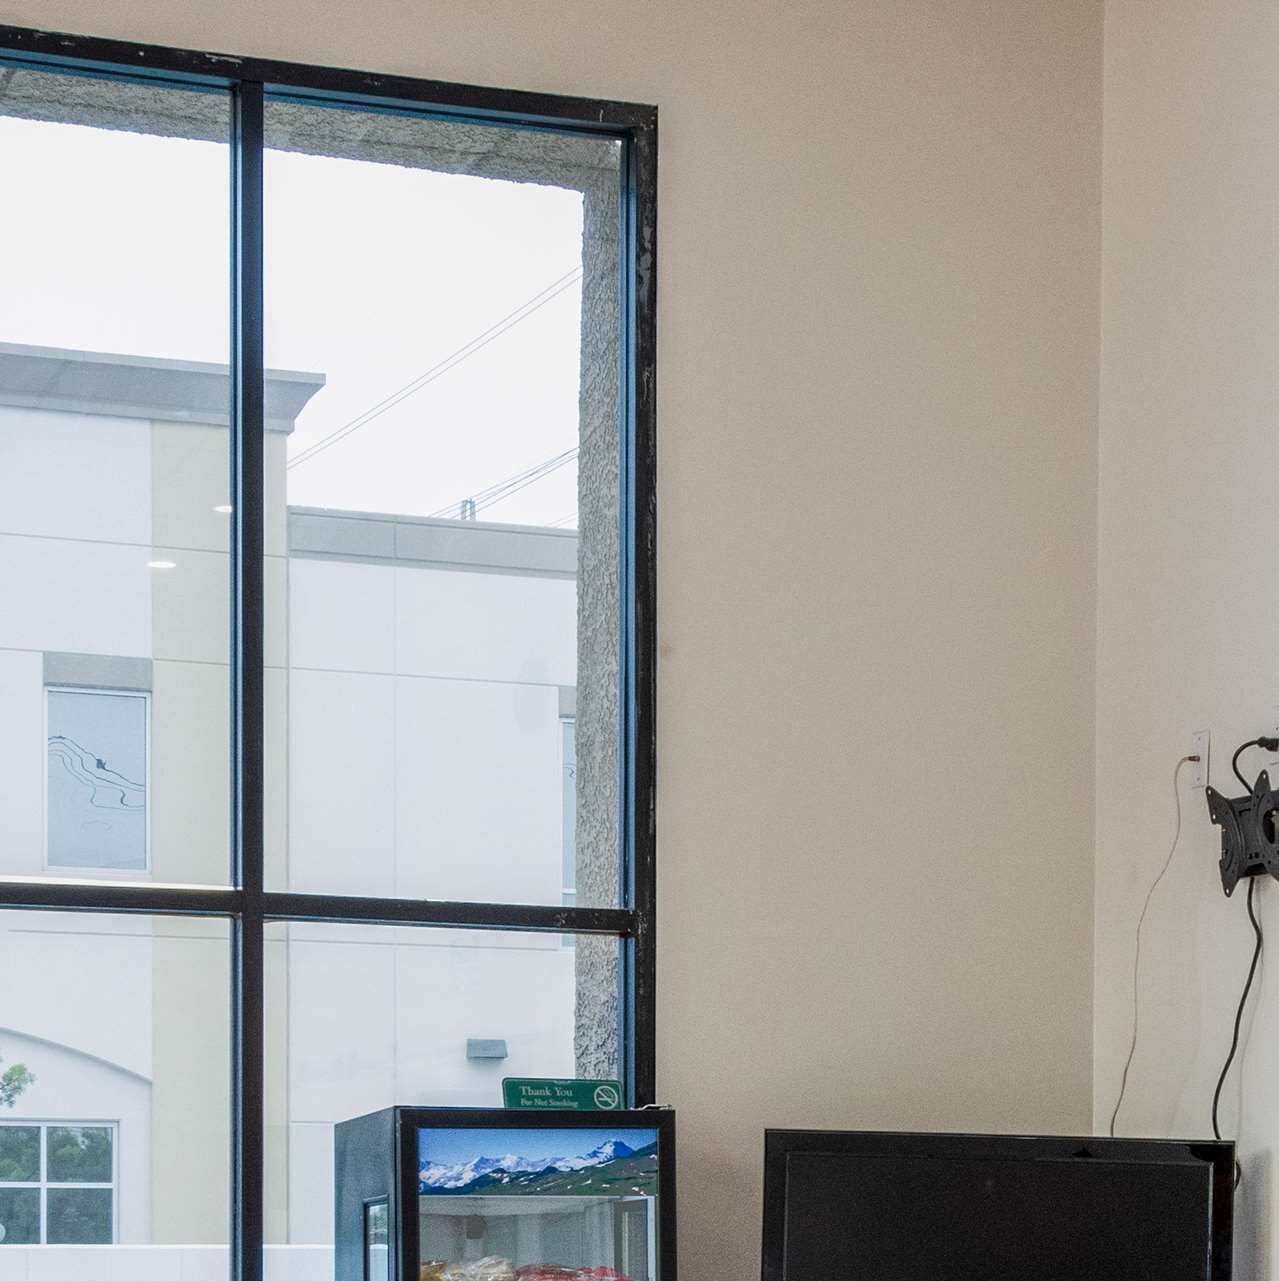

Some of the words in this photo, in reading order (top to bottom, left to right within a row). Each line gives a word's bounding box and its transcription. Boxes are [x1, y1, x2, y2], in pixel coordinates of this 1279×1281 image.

[519, 1086, 552, 1096] Thank
[554, 1087, 573, 1097] You
[549, 1099, 578, 1108] Smoking
